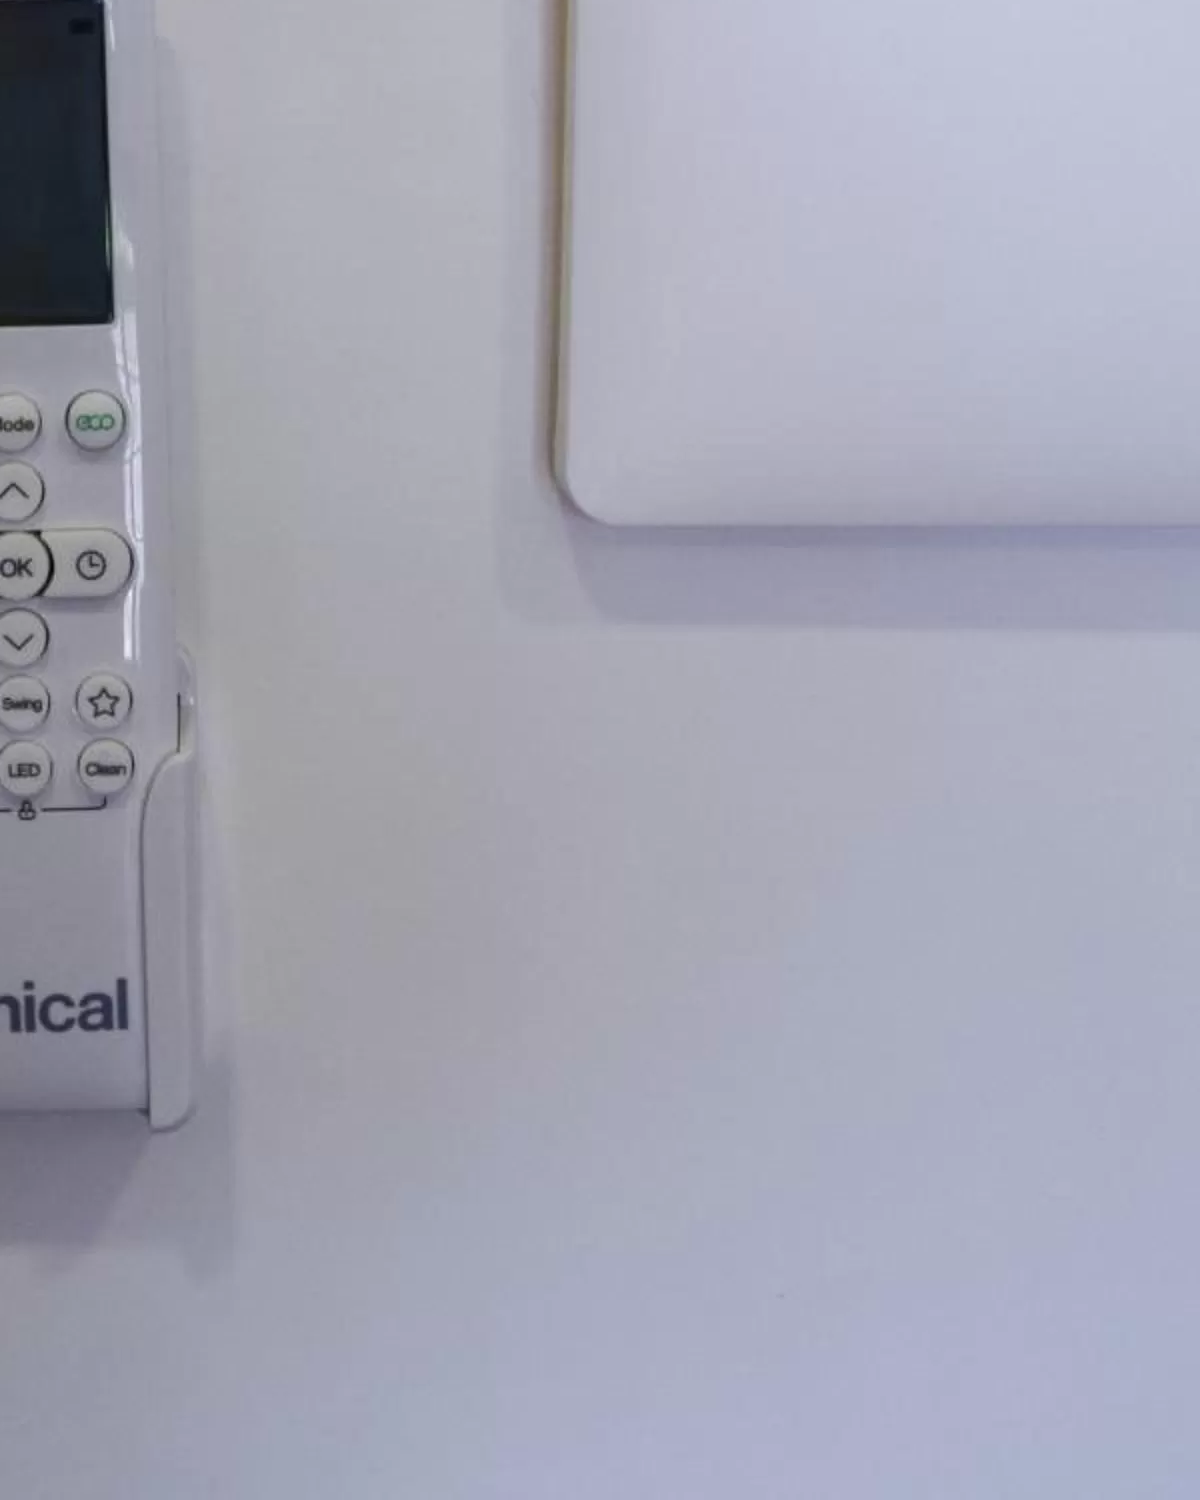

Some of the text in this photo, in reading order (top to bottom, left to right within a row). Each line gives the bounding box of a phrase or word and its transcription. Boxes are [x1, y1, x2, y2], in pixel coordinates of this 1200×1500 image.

[0, 558, 33, 578] OK
[2, 696, 43, 713] Swing
[8, 762, 41, 778] LED
[85, 761, 127, 777] Clean
